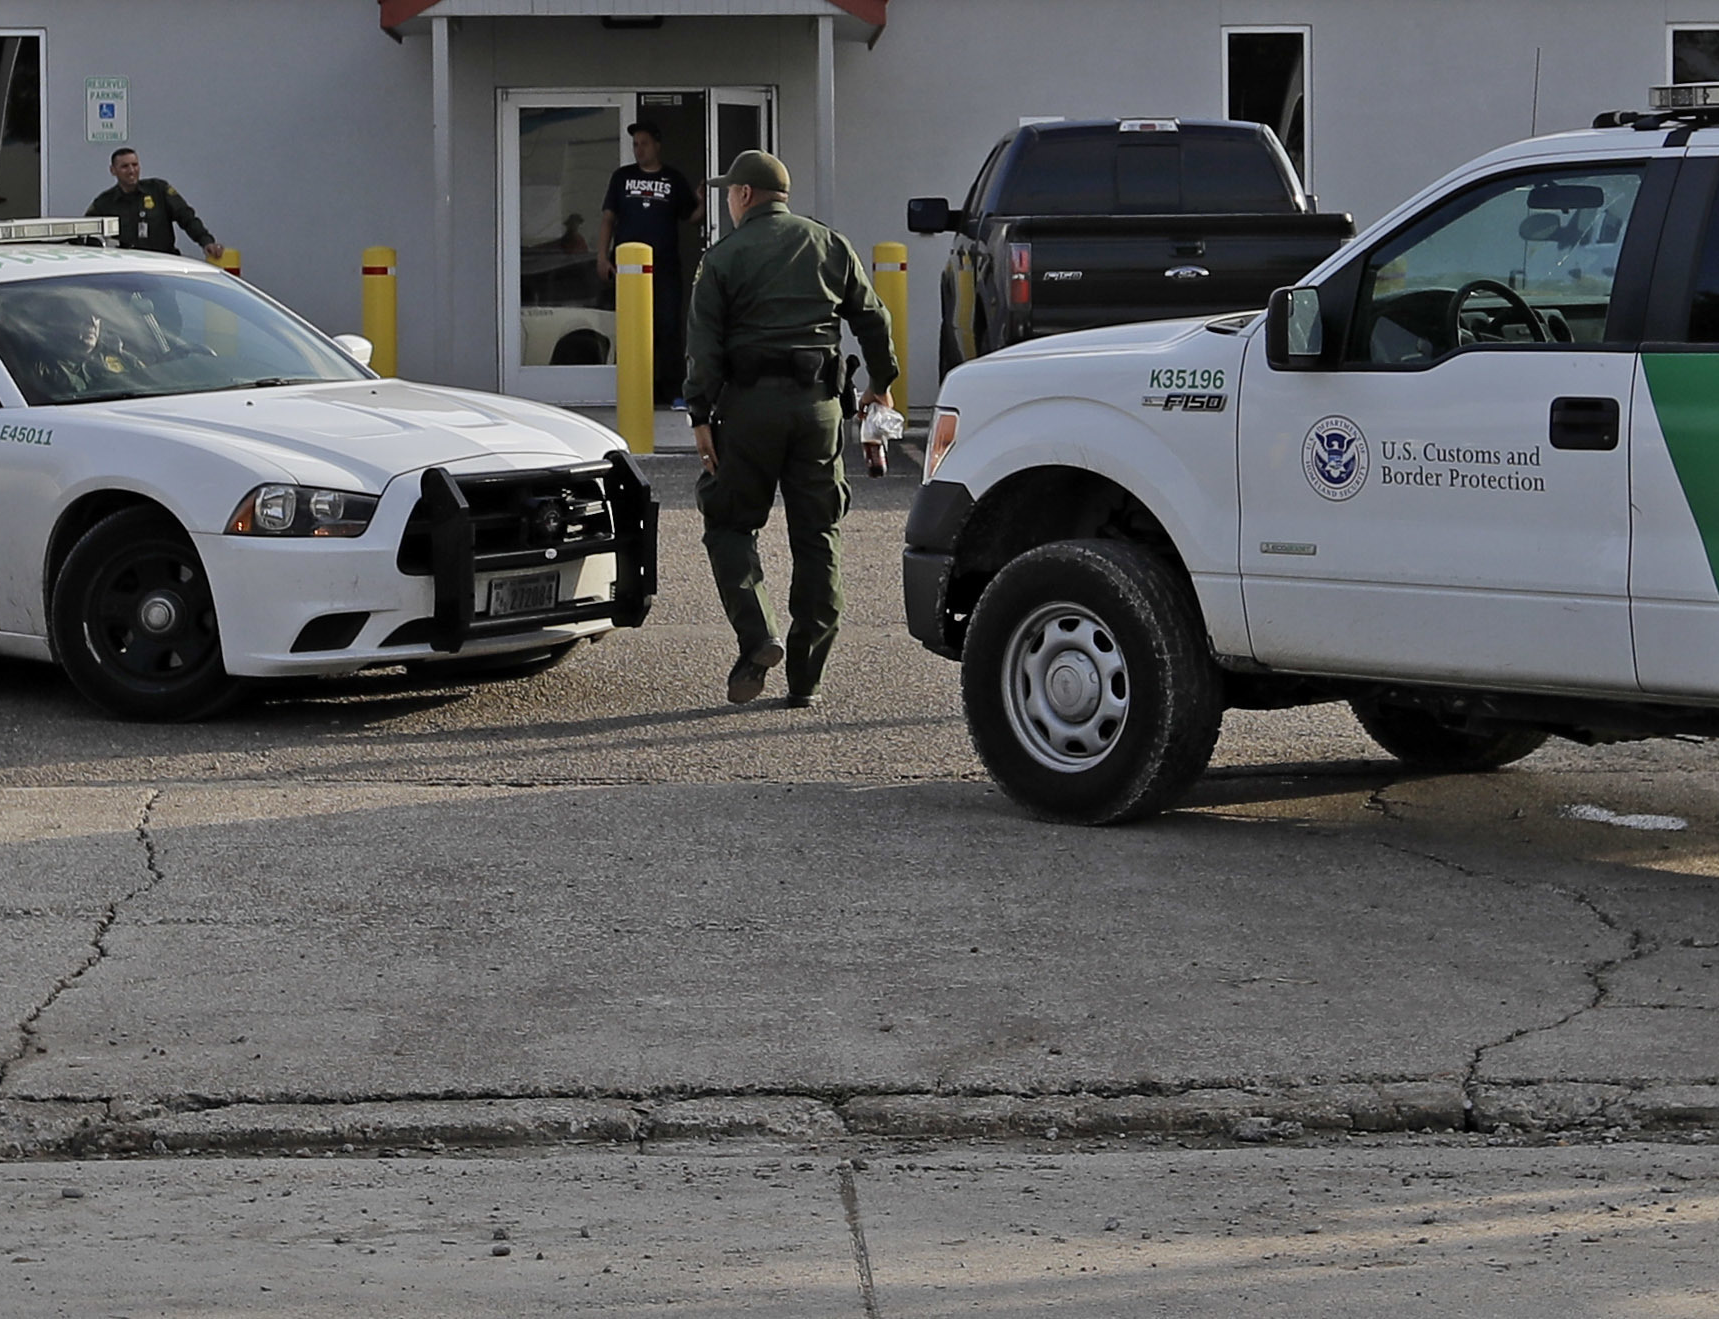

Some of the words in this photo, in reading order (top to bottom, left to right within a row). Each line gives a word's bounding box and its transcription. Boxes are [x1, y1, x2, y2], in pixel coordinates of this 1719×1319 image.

[625, 179, 671, 195] HUSKIES
[1149, 369, 1225, 389] K35196
[0, 424, 53, 446] E45011
[1381, 441, 1417, 461] U.S.
[1423, 443, 1501, 465] Customs
[1507, 446, 1540, 466] and
[1305, 459, 1337, 497] HOMELAND
[1338, 465, 1366, 498] SECURITY
[1381, 465, 1442, 486] Border
[1449, 468, 1545, 491] Protection
